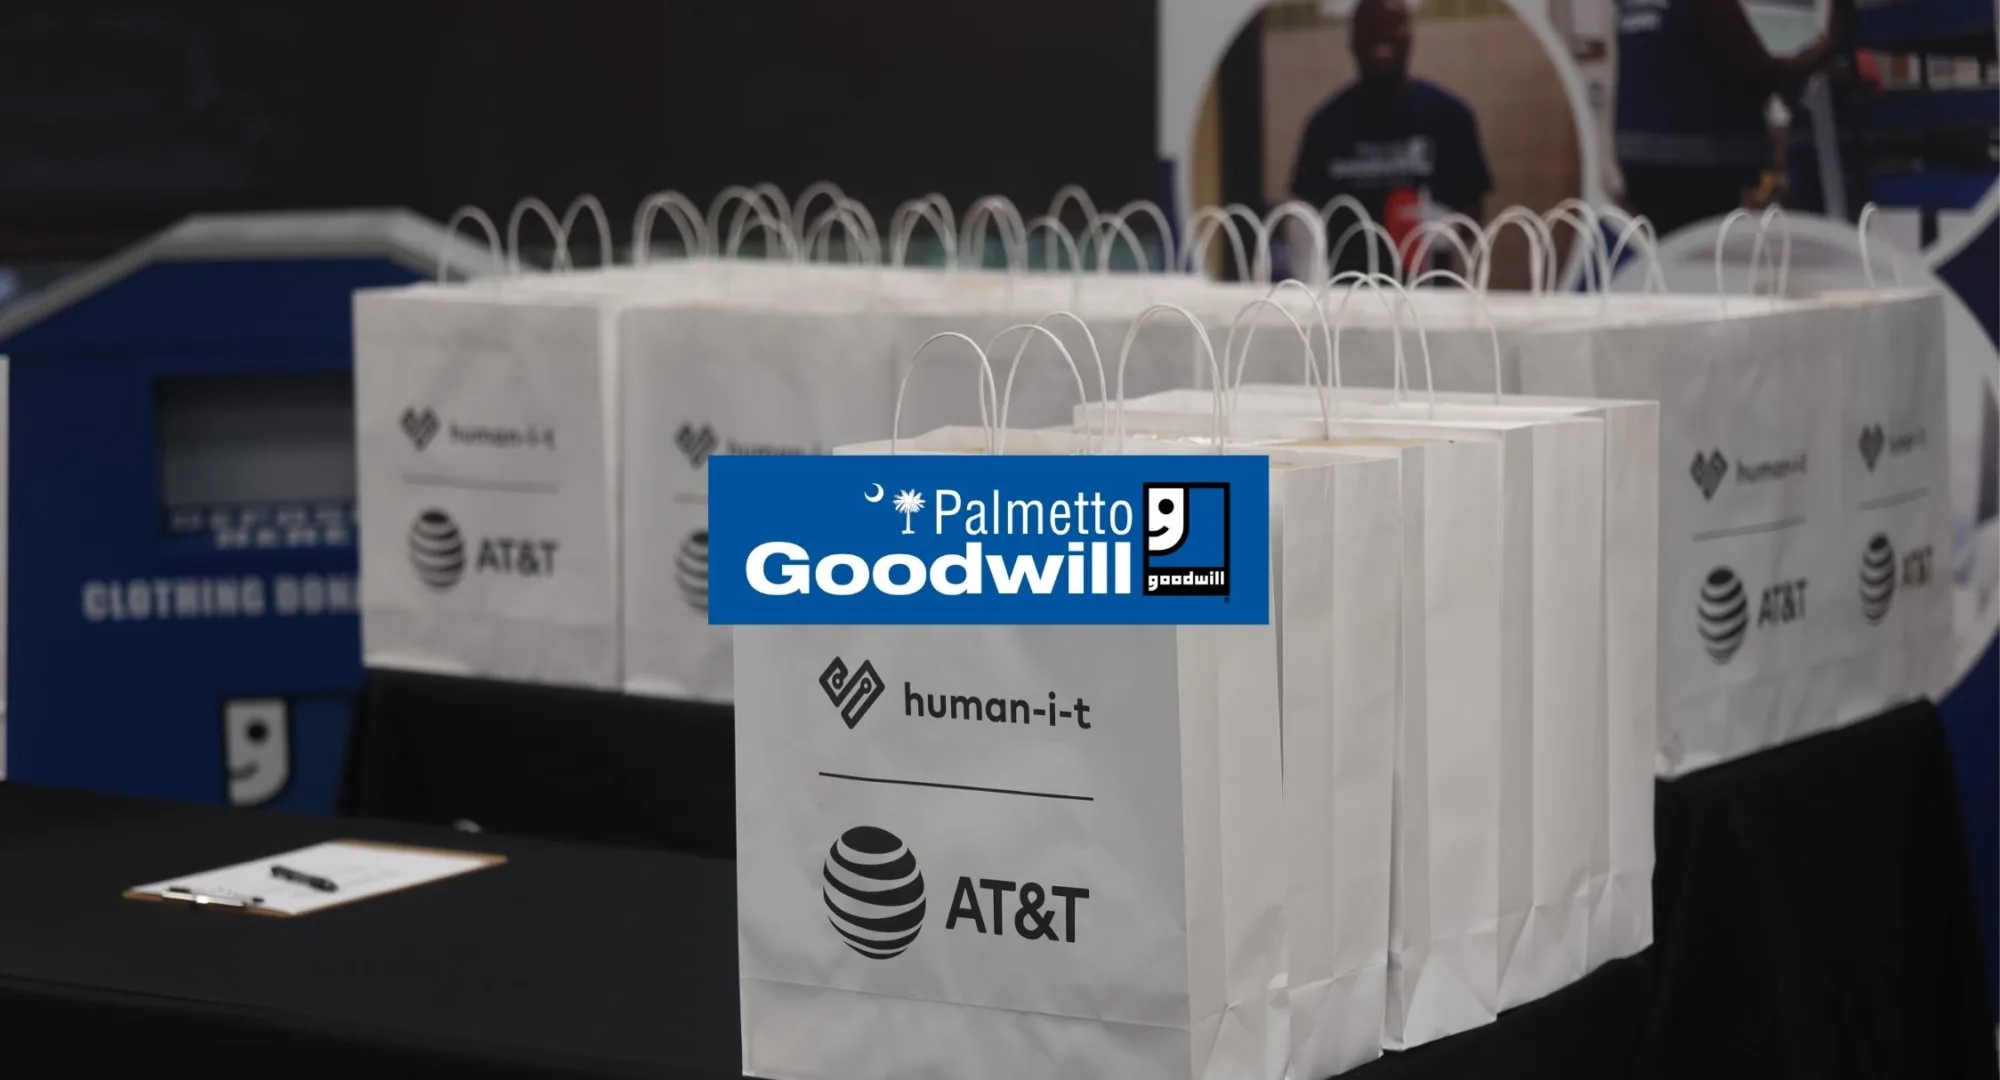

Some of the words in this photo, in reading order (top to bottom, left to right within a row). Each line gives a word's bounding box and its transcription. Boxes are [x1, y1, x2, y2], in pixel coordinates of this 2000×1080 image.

[475, 538, 559, 577] AT&T
[82, 577, 265, 620] CLOTHING
[904, 681, 1092, 730] human-i-t
[945, 876, 1090, 944] AT&T
